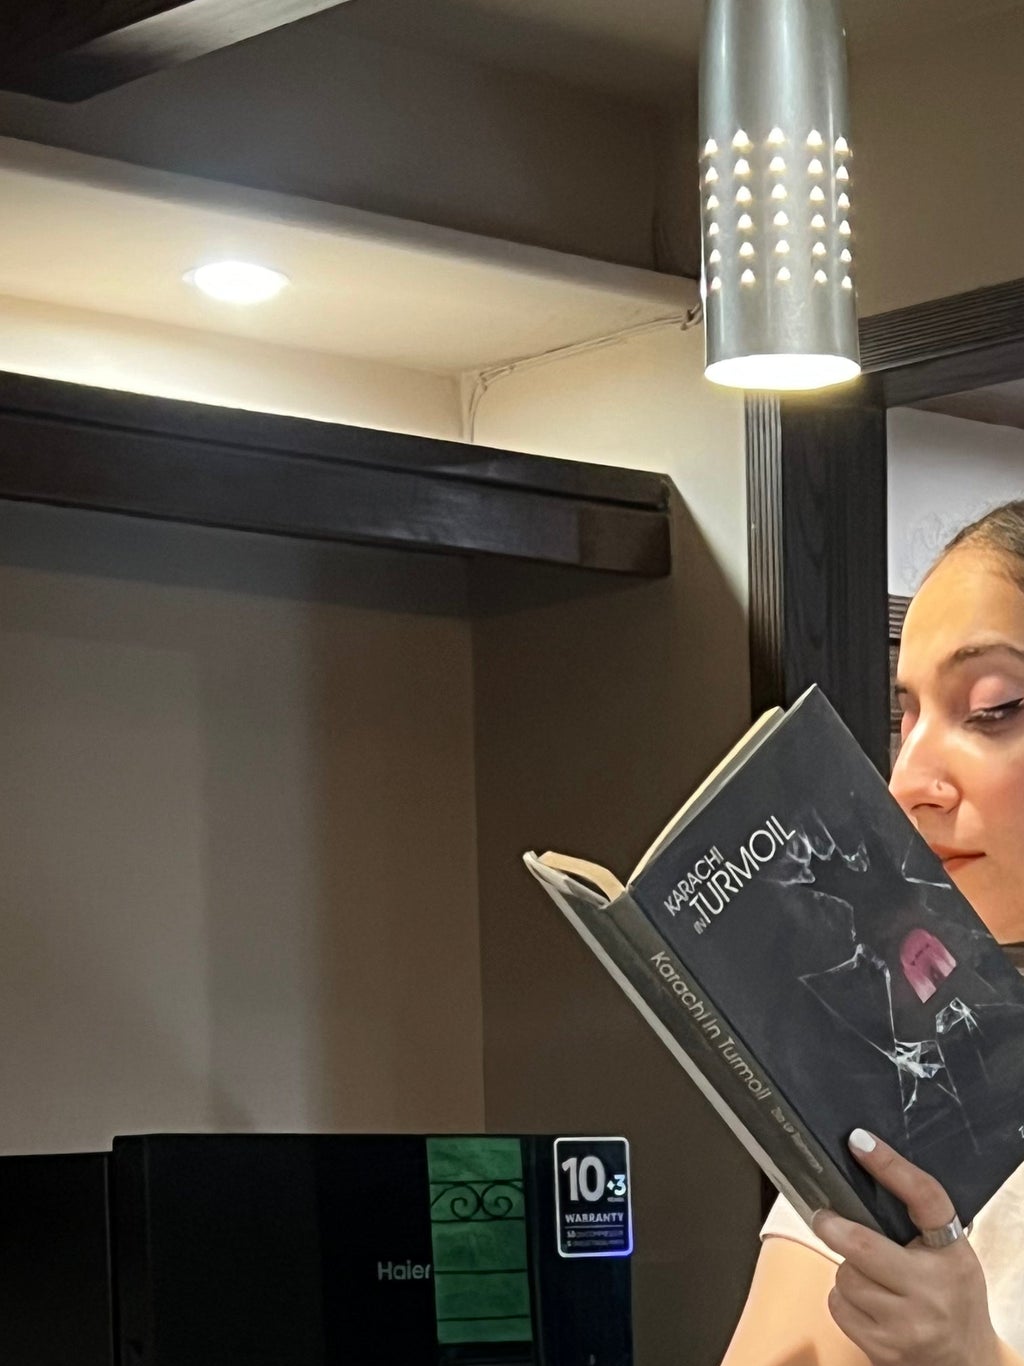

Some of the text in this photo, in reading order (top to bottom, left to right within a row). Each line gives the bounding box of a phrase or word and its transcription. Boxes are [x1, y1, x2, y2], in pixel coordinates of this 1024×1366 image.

[663, 845, 724, 917] KARACHI
[689, 815, 797, 924] TURMOIL
[650, 951, 772, 1101] Karachi In Turmoil
[561, 1155, 606, 1202] 10
[565, 1213, 625, 1223] WARRANTY
[377, 1259, 431, 1281] Haier
